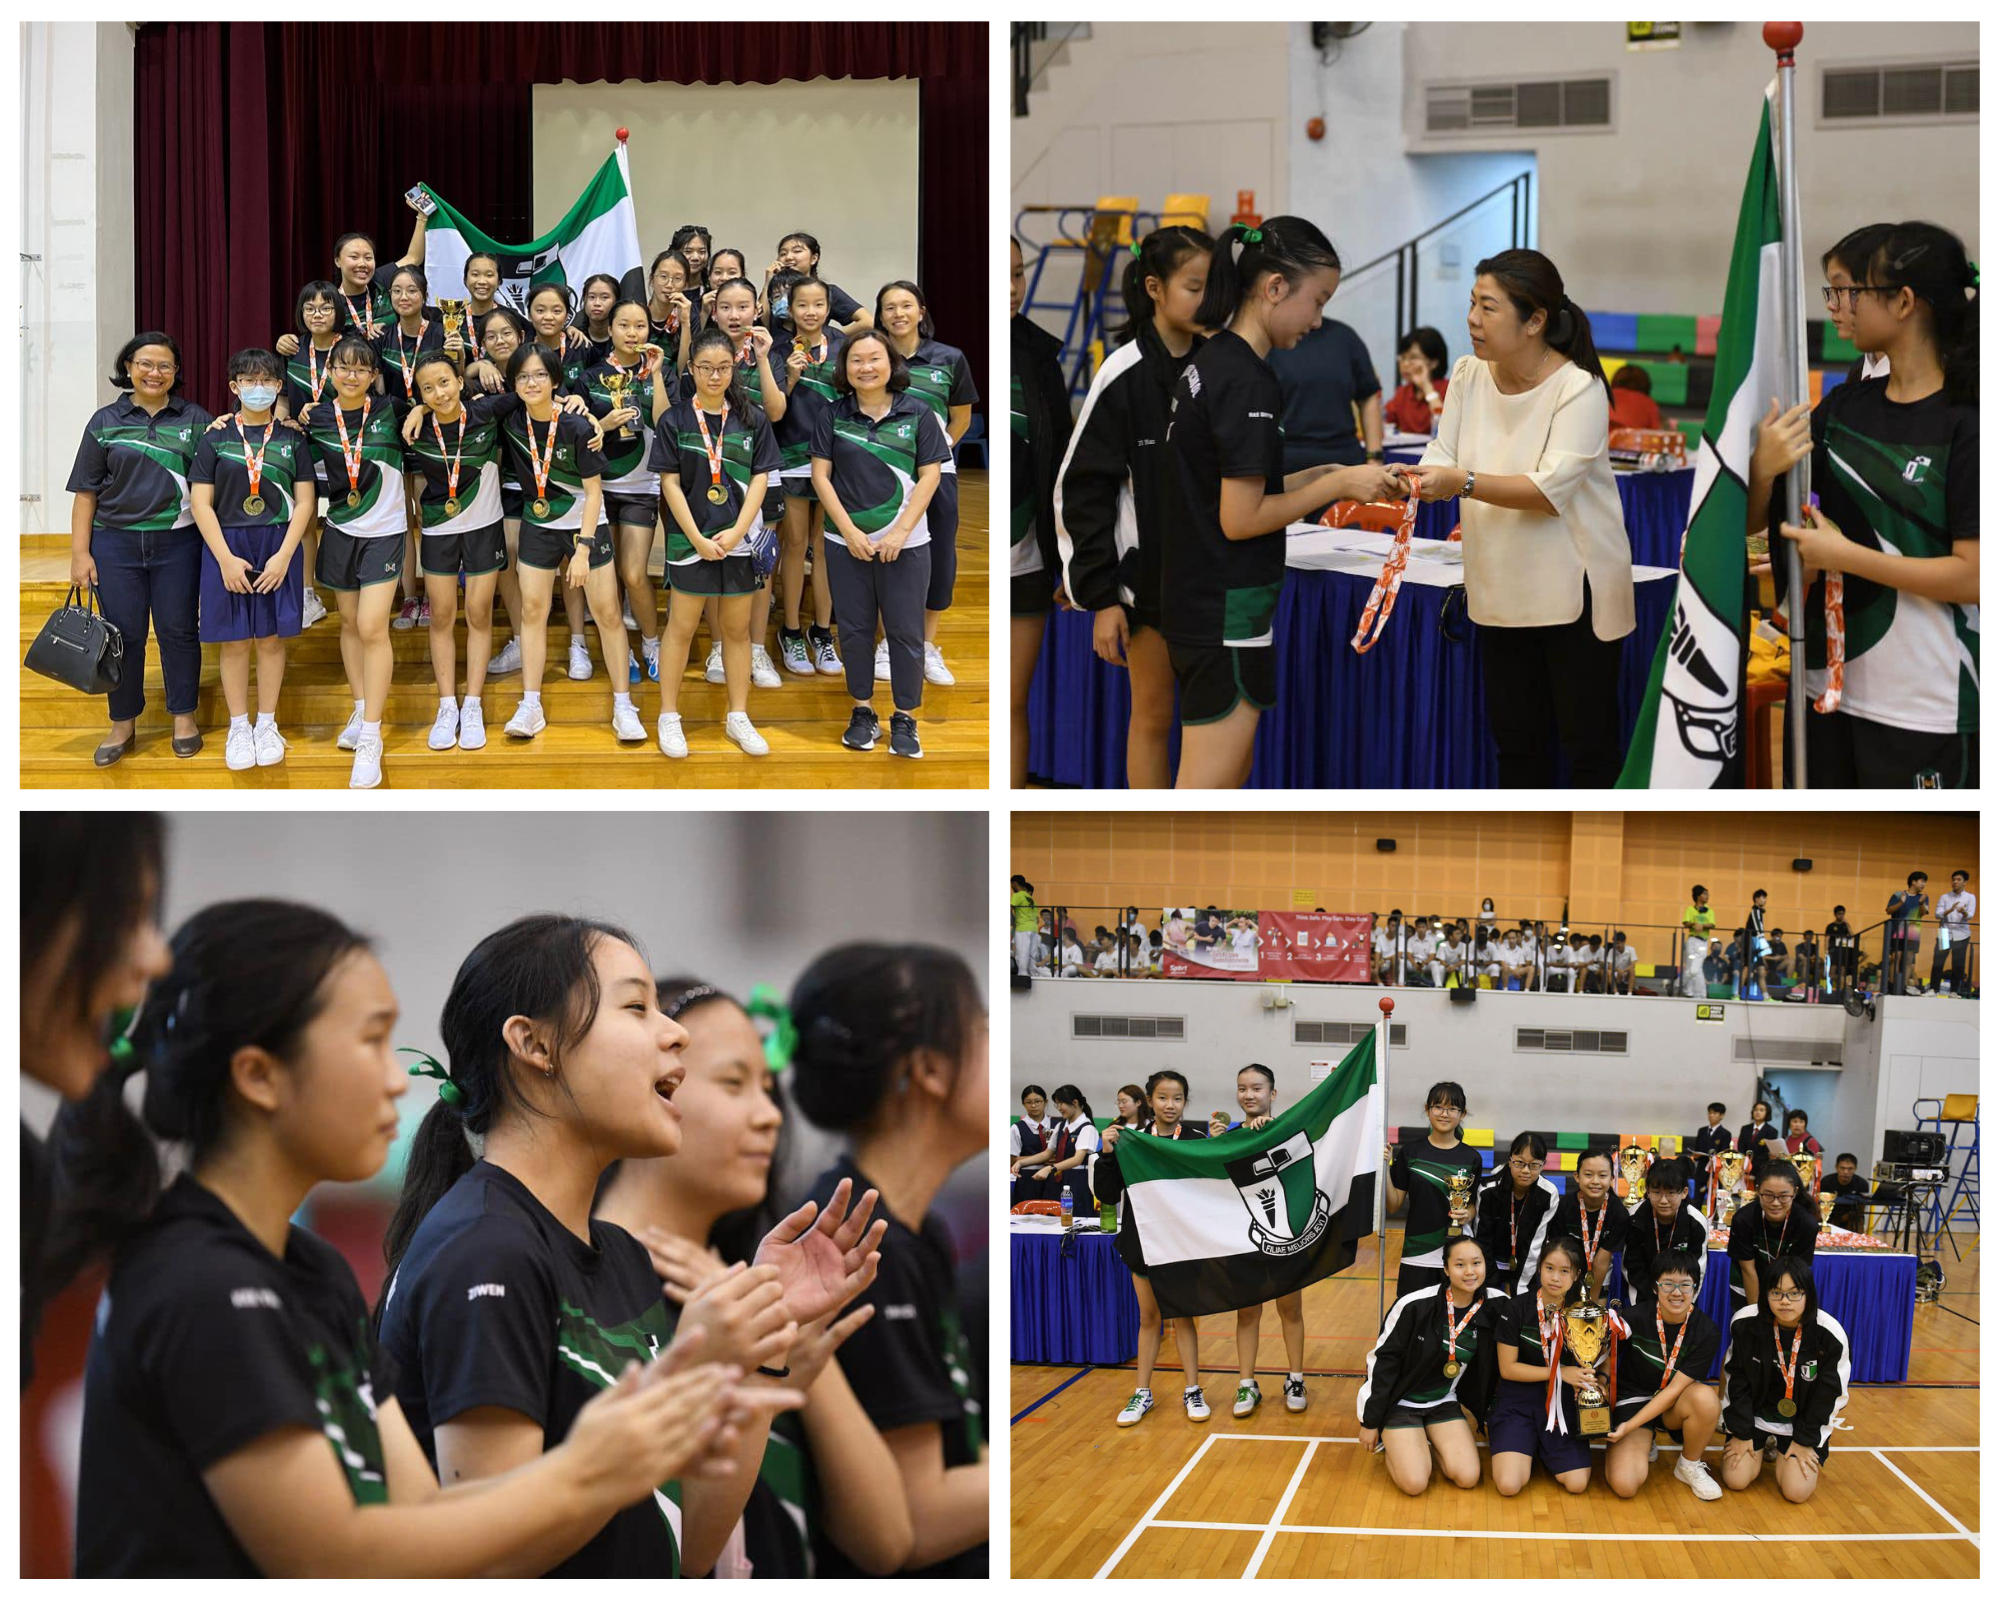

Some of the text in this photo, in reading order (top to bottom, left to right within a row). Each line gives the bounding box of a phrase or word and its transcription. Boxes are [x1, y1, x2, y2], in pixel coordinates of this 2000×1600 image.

[1260, 951, 1264, 959] 1
[1287, 952, 1293, 960] 2
[1316, 953, 1322, 961] 3
[1344, 954, 1350, 962] 4
[1265, 1244, 1287, 1254] FILIAE
[1287, 1232, 1316, 1252] MELIORIS
[468, 1283, 505, 1300] ZIWEN
